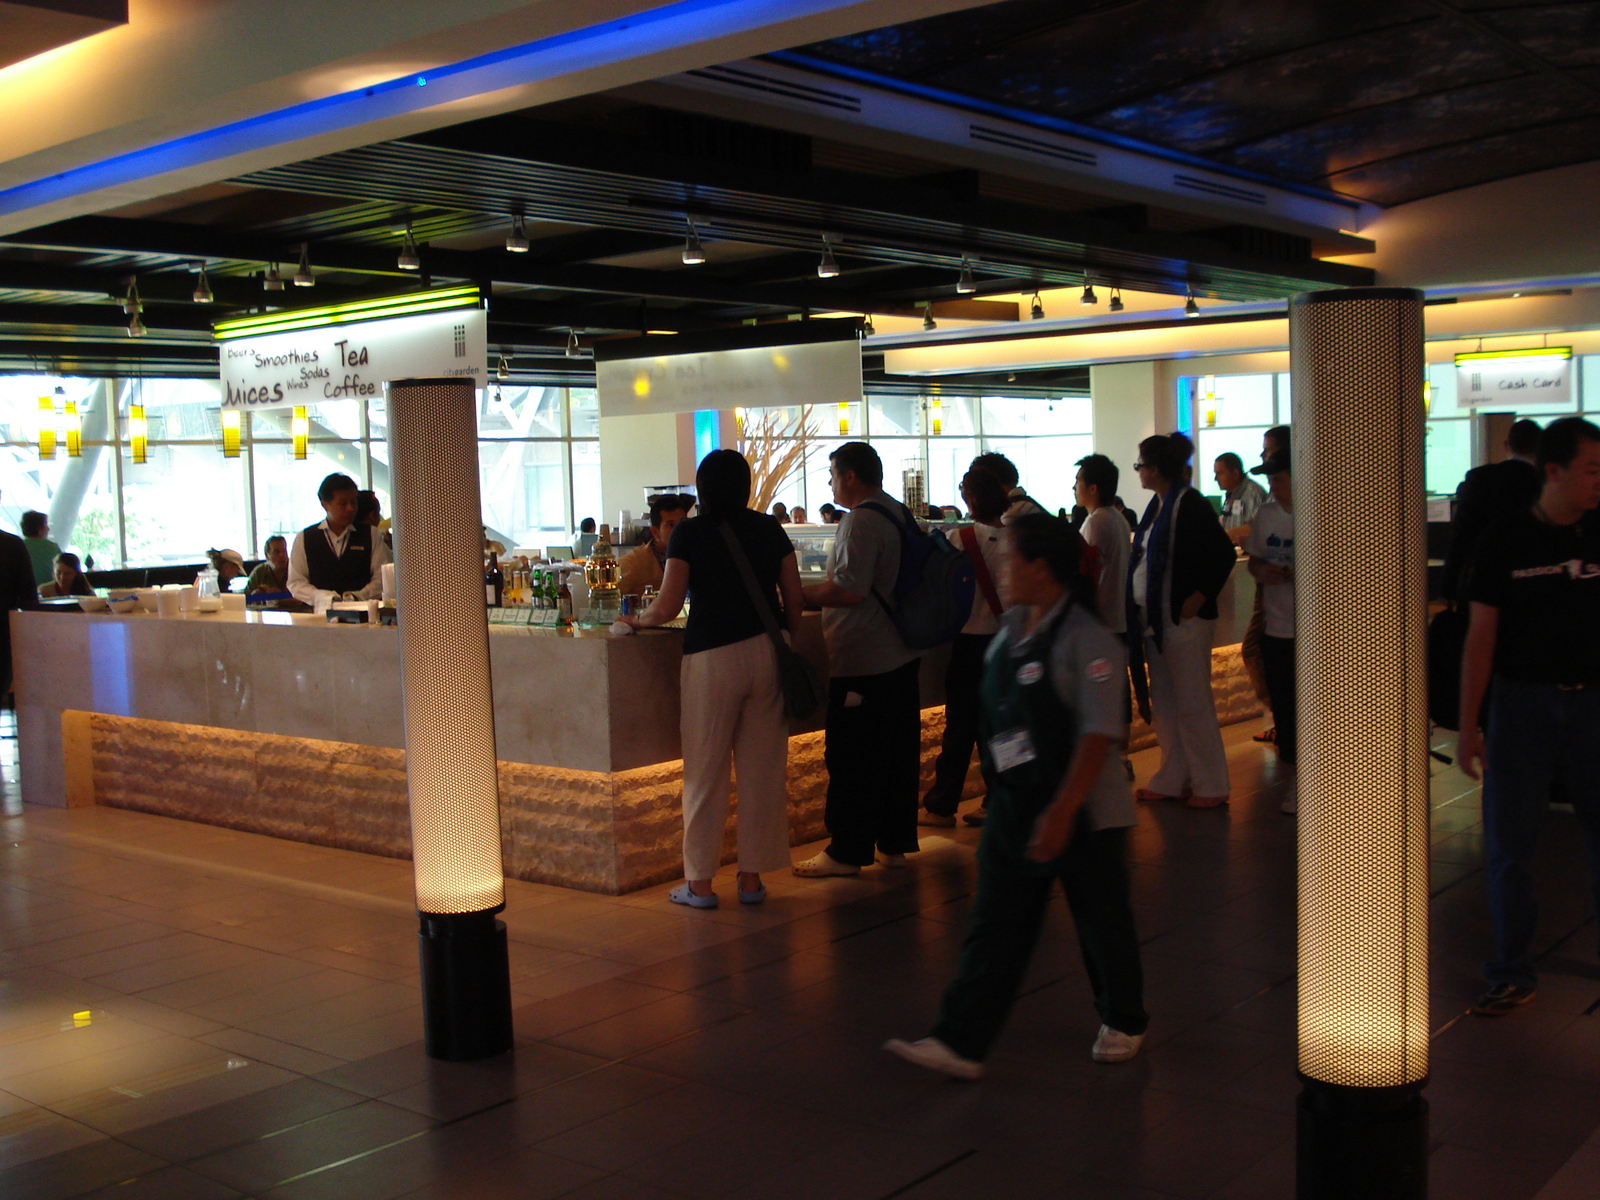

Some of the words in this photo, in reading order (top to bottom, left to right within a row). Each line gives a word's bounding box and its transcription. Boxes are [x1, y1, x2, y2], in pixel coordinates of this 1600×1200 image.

[254, 348, 319, 368] Smoothies
[334, 339, 369, 367] Tea
[300, 366, 330, 380] Sodas
[286, 378, 309, 391] Wines
[323, 375, 376, 399] Coffee
[1499, 378, 1528, 390] Cash
[1533, 377, 1562, 388] Card
[221, 377, 284, 408] Juices
[1460, 395, 1493, 405] garden
